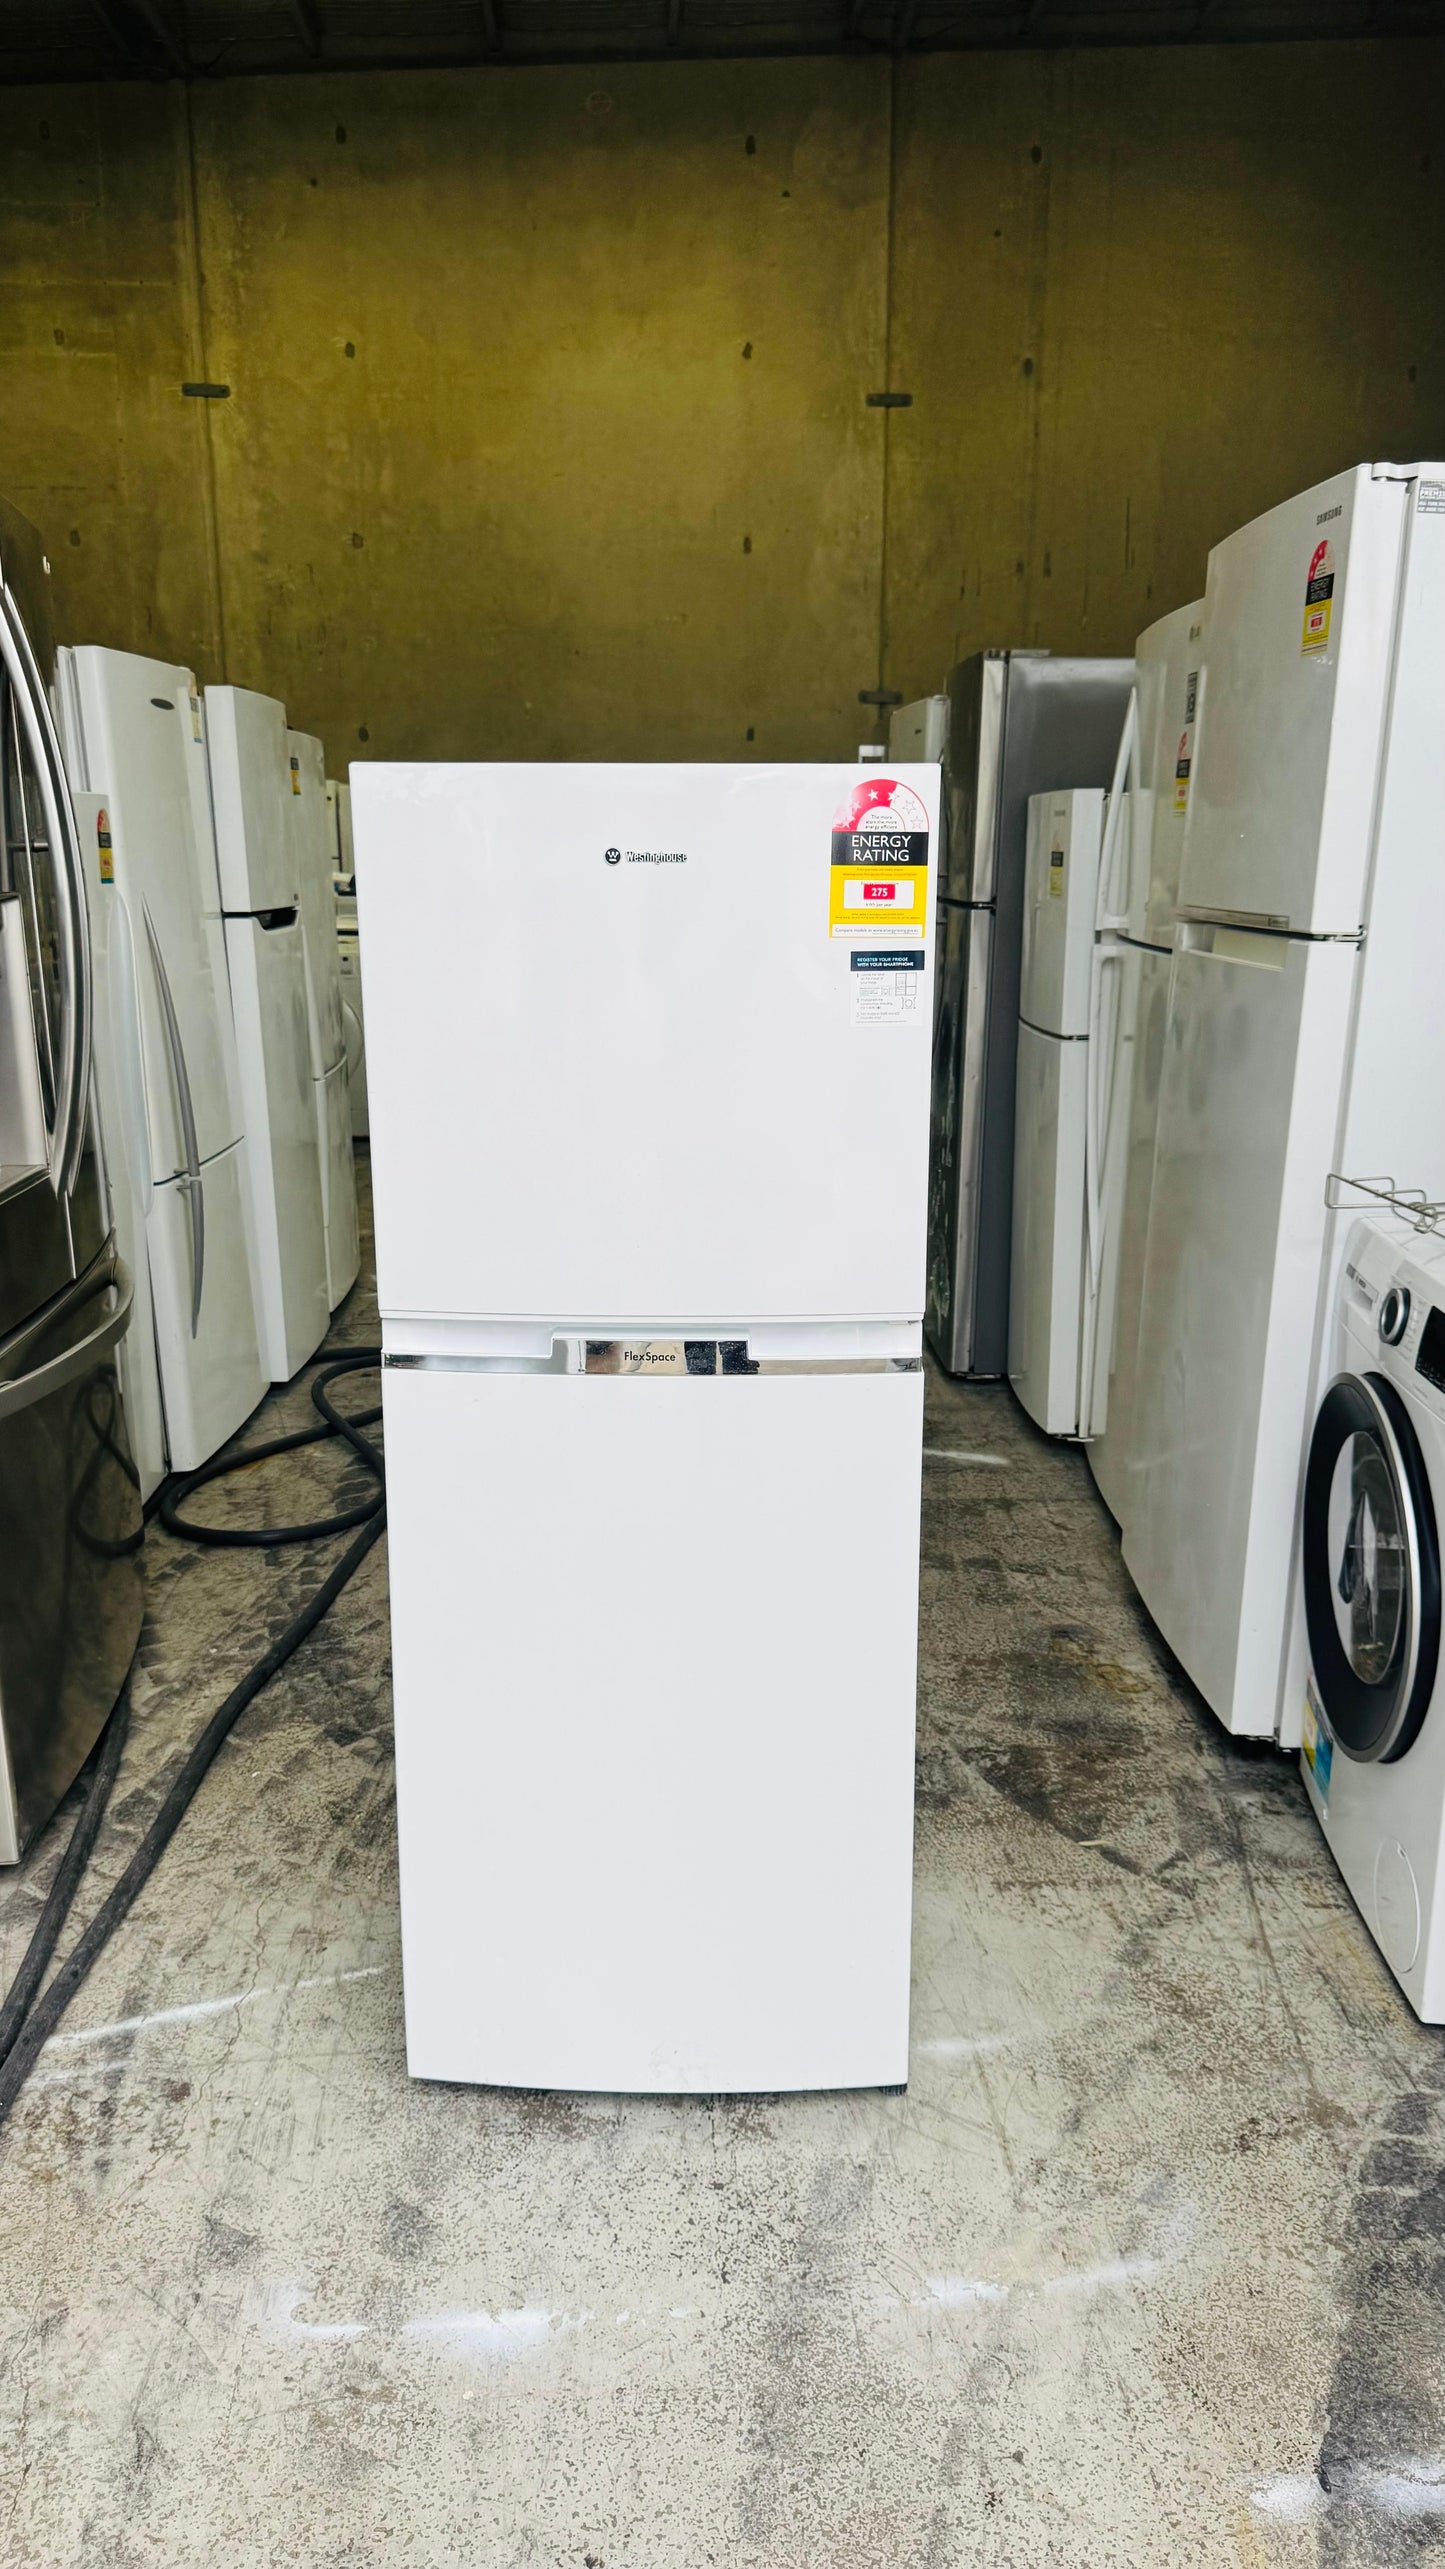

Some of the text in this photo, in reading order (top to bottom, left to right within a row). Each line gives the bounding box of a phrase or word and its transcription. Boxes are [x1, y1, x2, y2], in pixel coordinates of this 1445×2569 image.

[1316, 505, 1342, 526] SAMSUNG
[851, 835, 912, 848] ENERGY
[625, 851, 688, 865] Westinghouse
[853, 849, 910, 862] RATING
[871, 887, 888, 897] 275
[624, 1351, 676, 1364] FlexSpace
